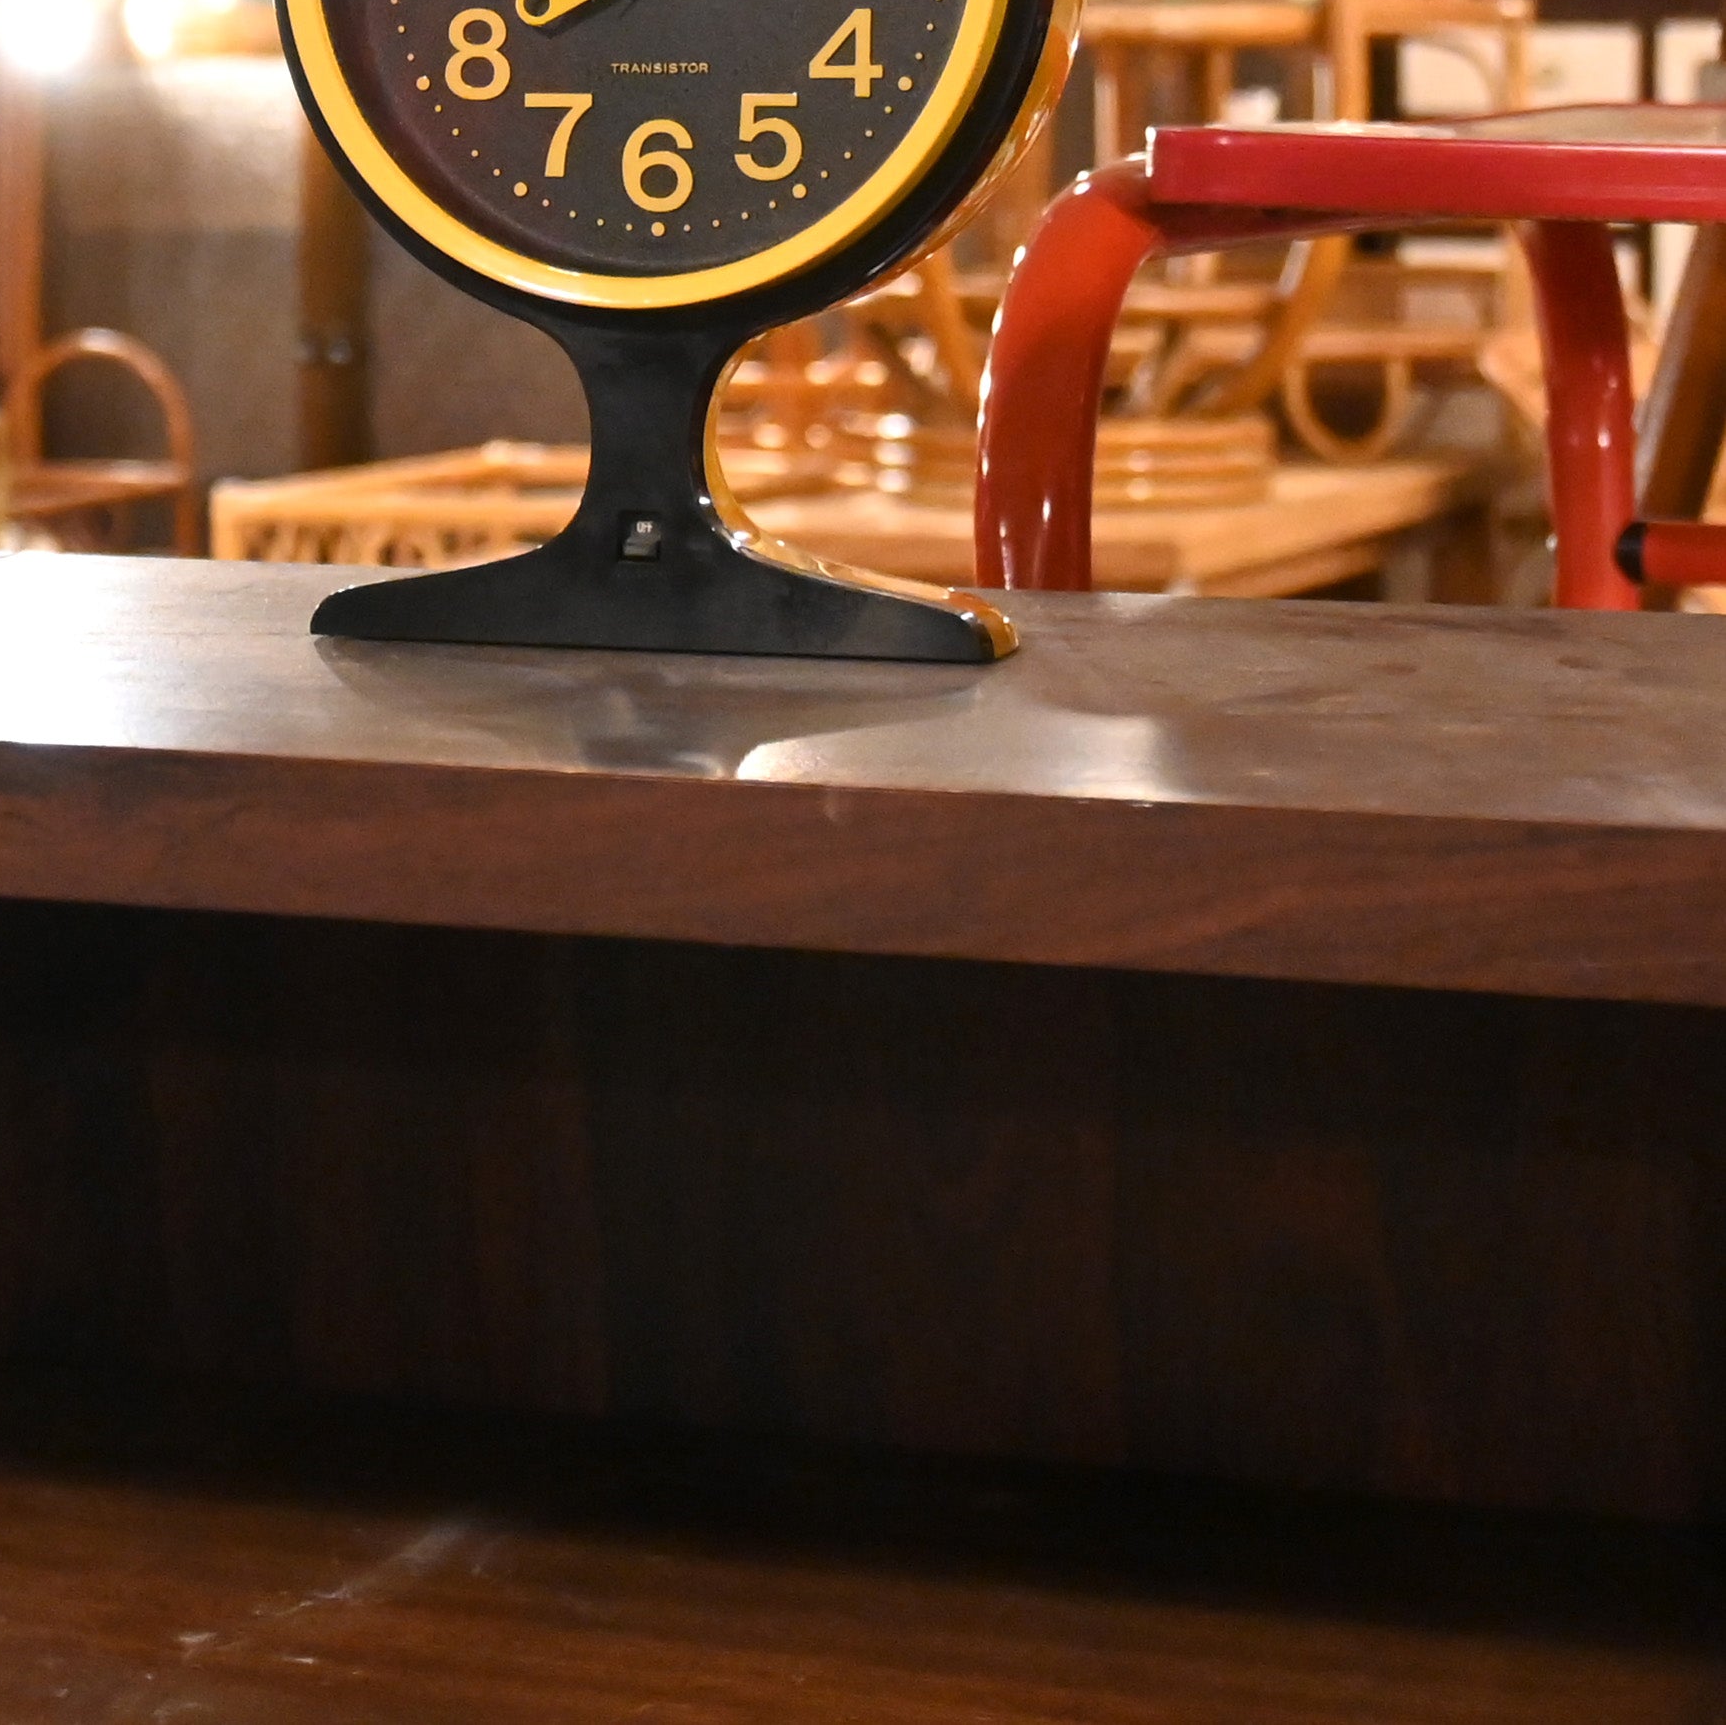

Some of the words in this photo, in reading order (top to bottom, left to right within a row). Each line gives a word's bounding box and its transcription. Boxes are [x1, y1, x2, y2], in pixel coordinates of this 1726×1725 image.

[444, 8, 510, 100] 8
[610, 62, 709, 74] TRANSISTOR
[809, 8, 883, 97] 4
[524, 93, 593, 177] 7
[621, 119, 694, 213] 6
[735, 92, 803, 181] 5
